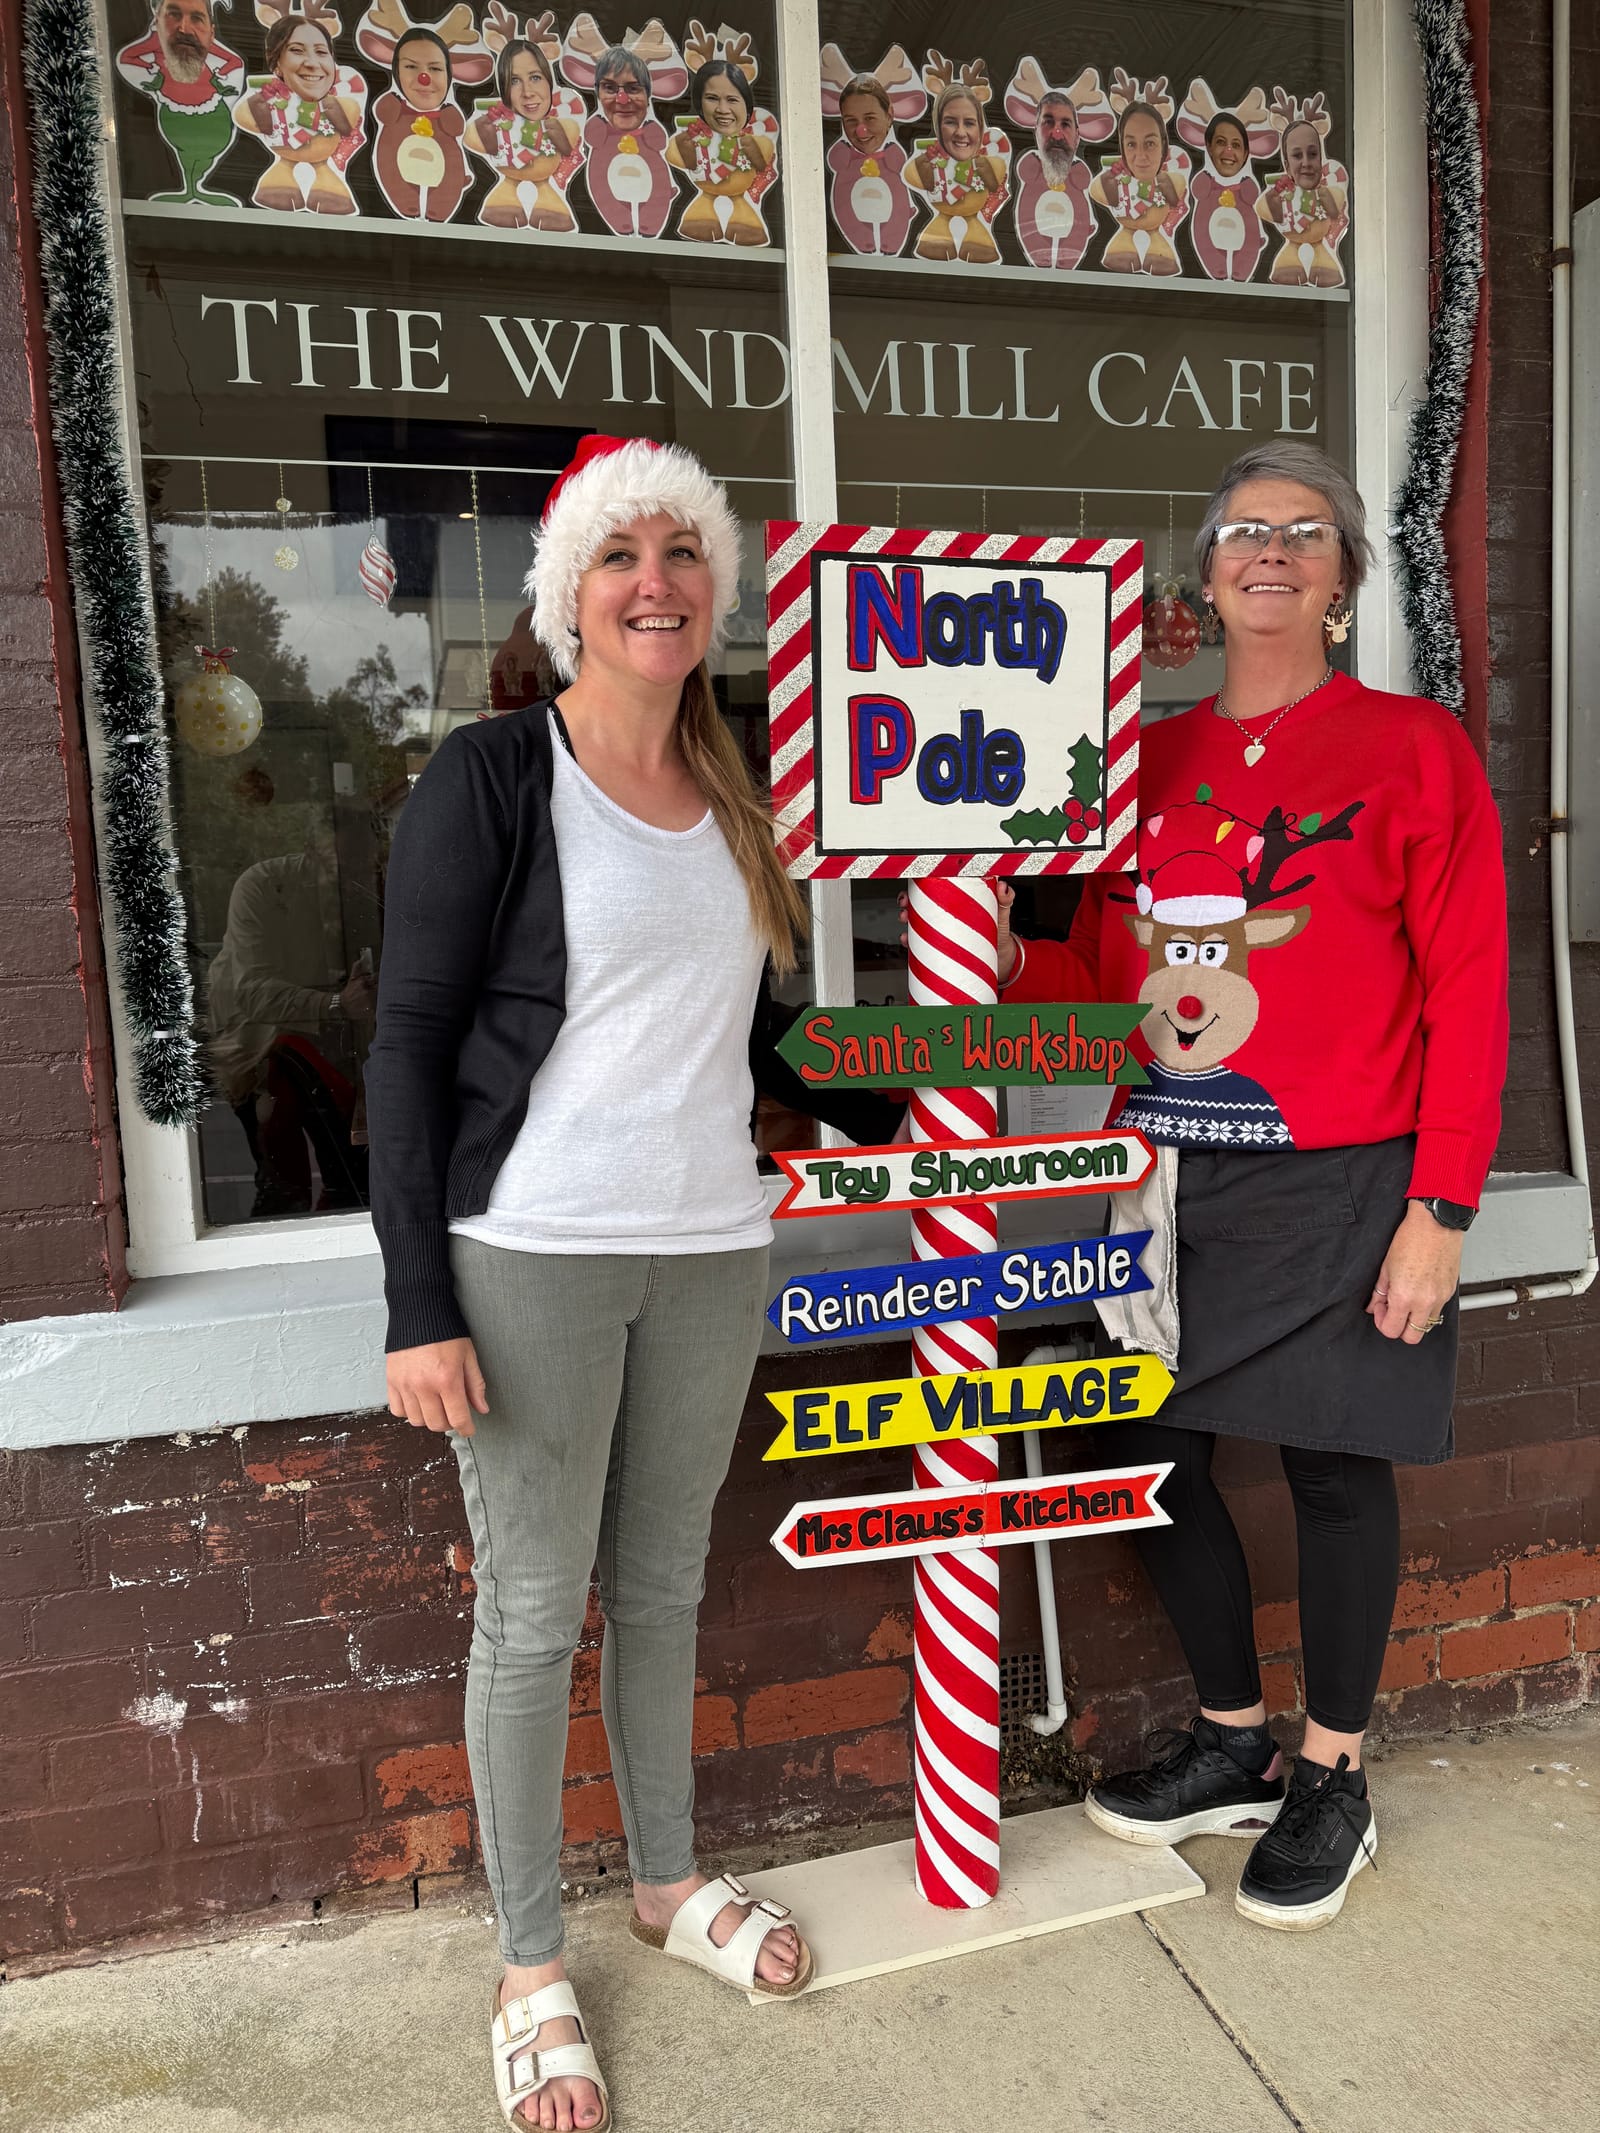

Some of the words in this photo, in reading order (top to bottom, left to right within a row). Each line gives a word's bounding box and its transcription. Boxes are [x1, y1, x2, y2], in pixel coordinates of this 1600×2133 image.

[201, 294, 449, 394] THE
[480, 314, 1060, 424] WINDMILL
[1088, 352, 1318, 434] CAFE
[846, 563, 1067, 684] North
[849, 693, 1026, 806] Pole
[800, 1014, 954, 1082] Santa's
[963, 1012, 1128, 1085] Workshop
[806, 1160, 891, 1205] Toy
[909, 1141, 1129, 1199] Showroom
[779, 1275, 983, 1338] Reindeer
[994, 1242, 1132, 1311] Stable
[793, 1392, 903, 1452] ELF
[921, 1365, 1140, 1432] VILLAGE
[797, 1514, 853, 1557] Mrs
[858, 1504, 985, 1547] Claus's
[1000, 1486, 1134, 1530] Kitchen
